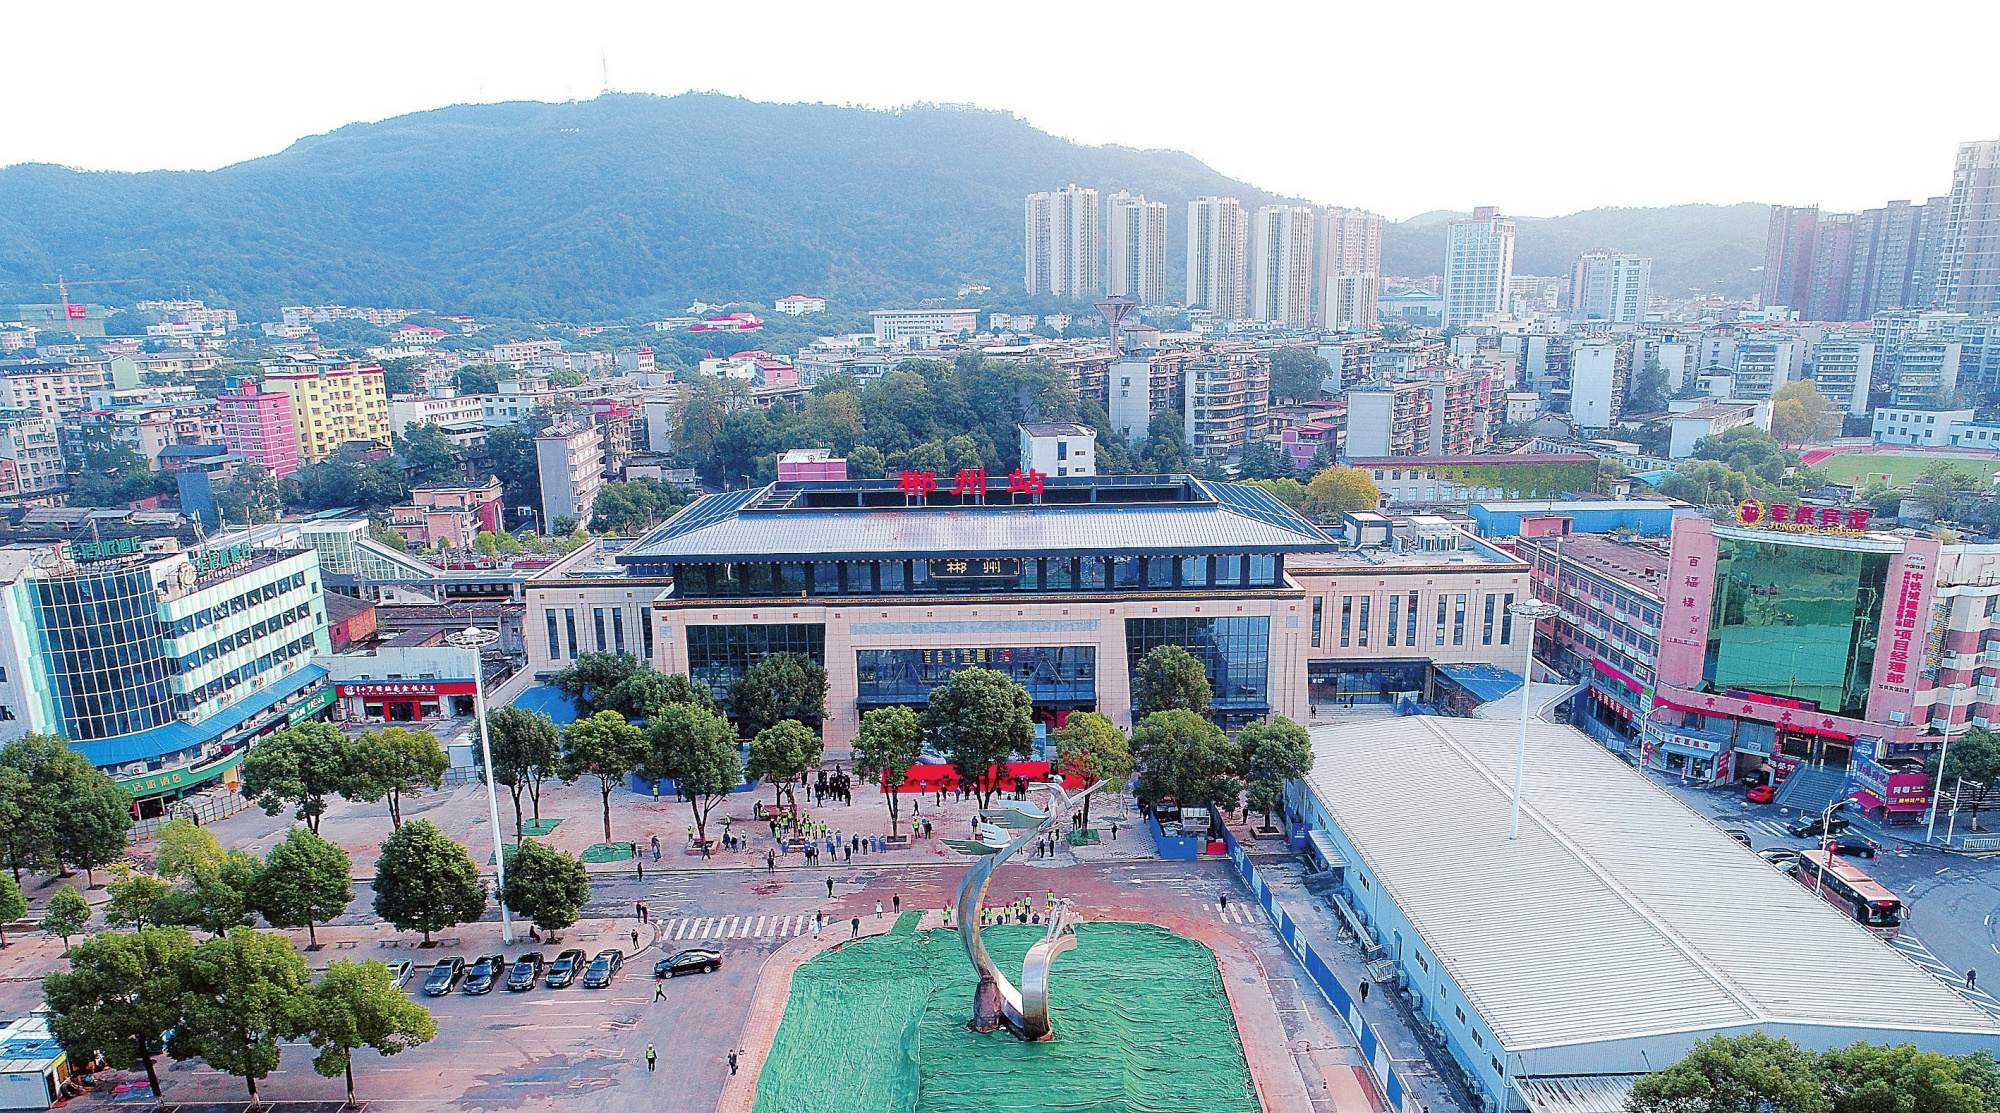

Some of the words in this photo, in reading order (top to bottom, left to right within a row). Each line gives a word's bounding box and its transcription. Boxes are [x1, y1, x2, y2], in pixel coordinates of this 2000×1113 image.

[896, 467, 1048, 497] 郴州站
[1771, 503, 1869, 530] 军供宾馆
[61, 535, 144, 561] 生活派酒店
[196, 541, 252, 575] 生活派酒店
[946, 560, 1002, 574] 郴州
[1886, 628, 1912, 684] 项目经理部
